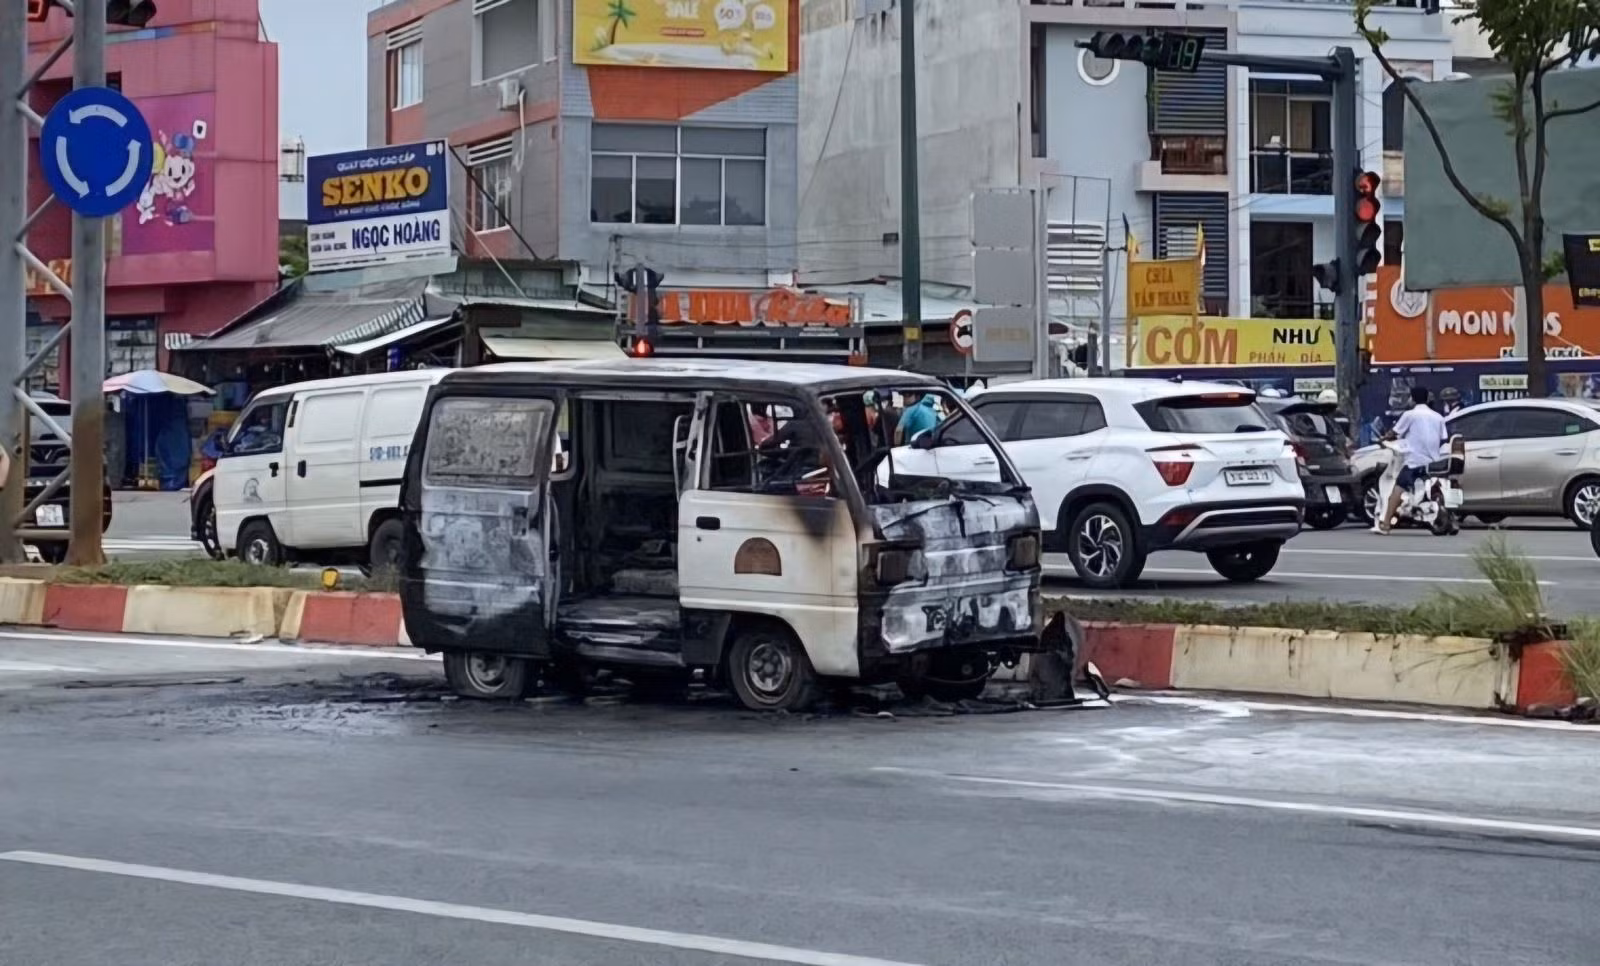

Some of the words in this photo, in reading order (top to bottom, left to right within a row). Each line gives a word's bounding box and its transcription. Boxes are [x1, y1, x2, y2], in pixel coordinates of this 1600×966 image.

[322, 166, 430, 207] SENKO
[352, 224, 390, 254] NGỌC
[393, 216, 440, 246] HOÀNG
[1272, 324, 1322, 346] NHƯ
[1438, 310, 1498, 336] MON
[1145, 320, 1238, 365] CƠM
